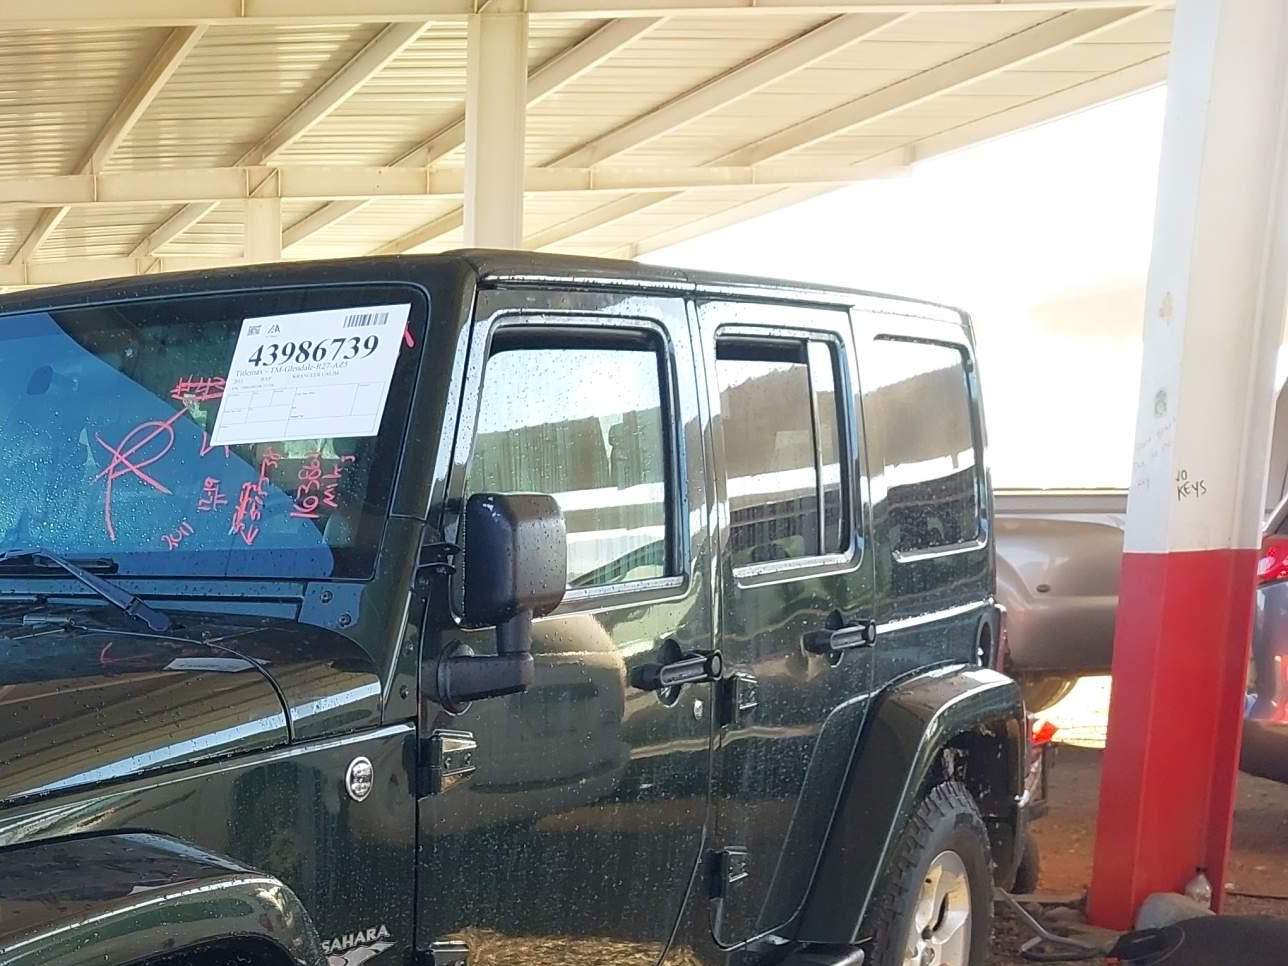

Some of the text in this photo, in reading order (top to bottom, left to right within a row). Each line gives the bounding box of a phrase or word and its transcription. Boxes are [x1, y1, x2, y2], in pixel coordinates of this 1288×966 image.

[247, 334, 380, 368] 43986739
[1177, 480, 1207, 501] KEYS
[321, 924, 391, 954] SAHARA
